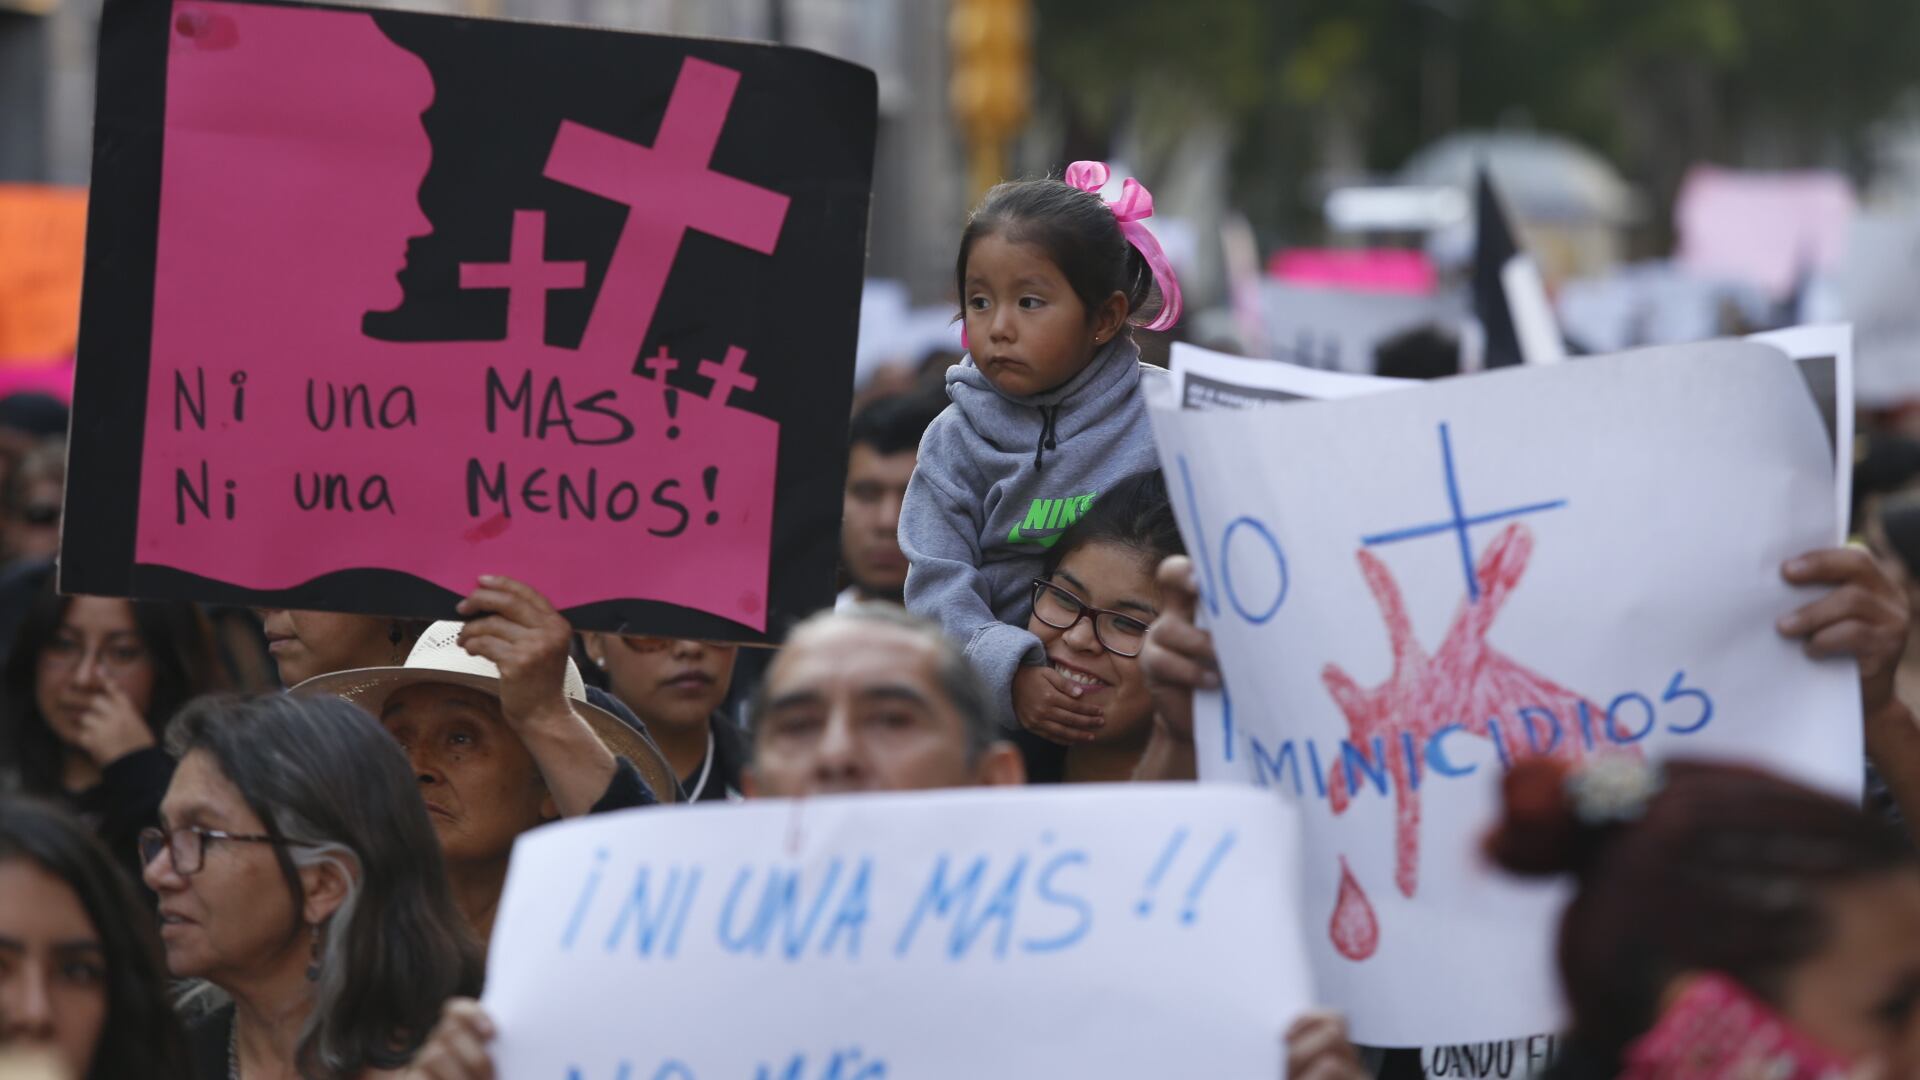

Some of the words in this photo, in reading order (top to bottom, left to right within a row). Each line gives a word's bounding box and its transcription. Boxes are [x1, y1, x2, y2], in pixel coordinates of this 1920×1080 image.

[174, 366, 247, 431] Ni
[306, 378, 417, 432] una
[176, 460, 237, 525] Ni
[294, 472, 396, 516] una
[465, 458, 720, 538] MENOS!
[716, 855, 875, 961] UNA
